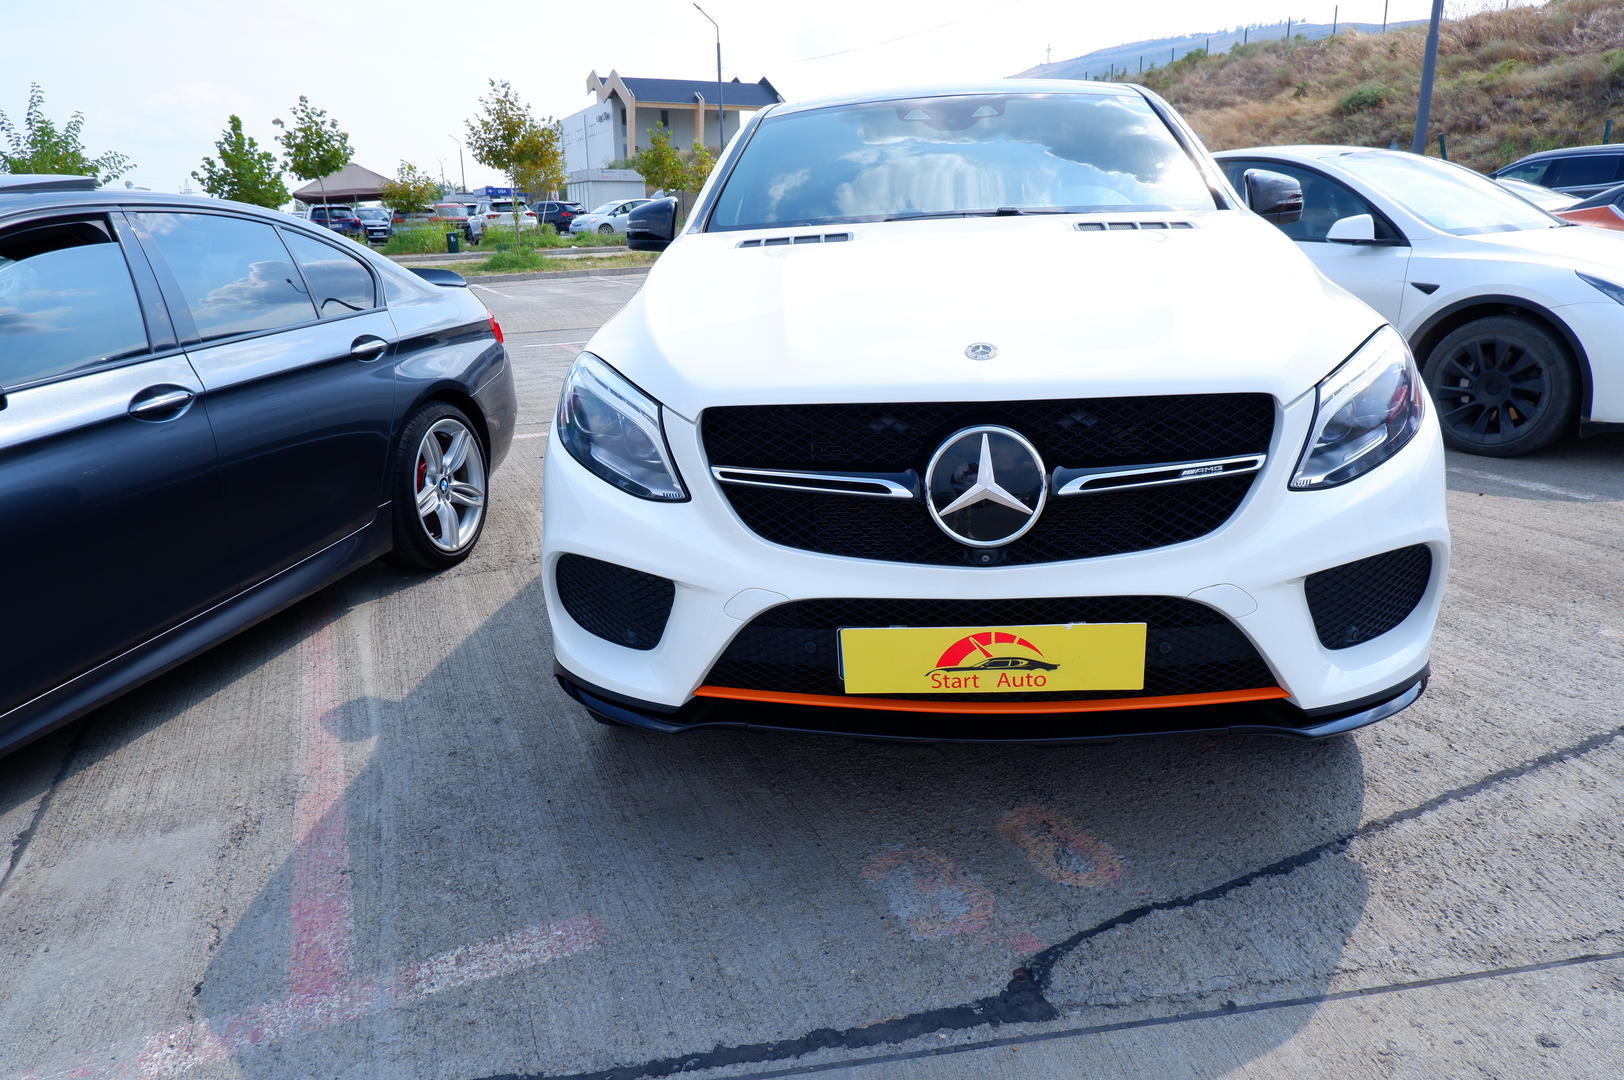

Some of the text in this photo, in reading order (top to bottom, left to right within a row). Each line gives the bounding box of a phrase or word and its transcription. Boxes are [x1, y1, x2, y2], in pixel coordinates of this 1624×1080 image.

[1194, 465, 1223, 474] AMG
[931, 672, 1047, 689] Start Auto
